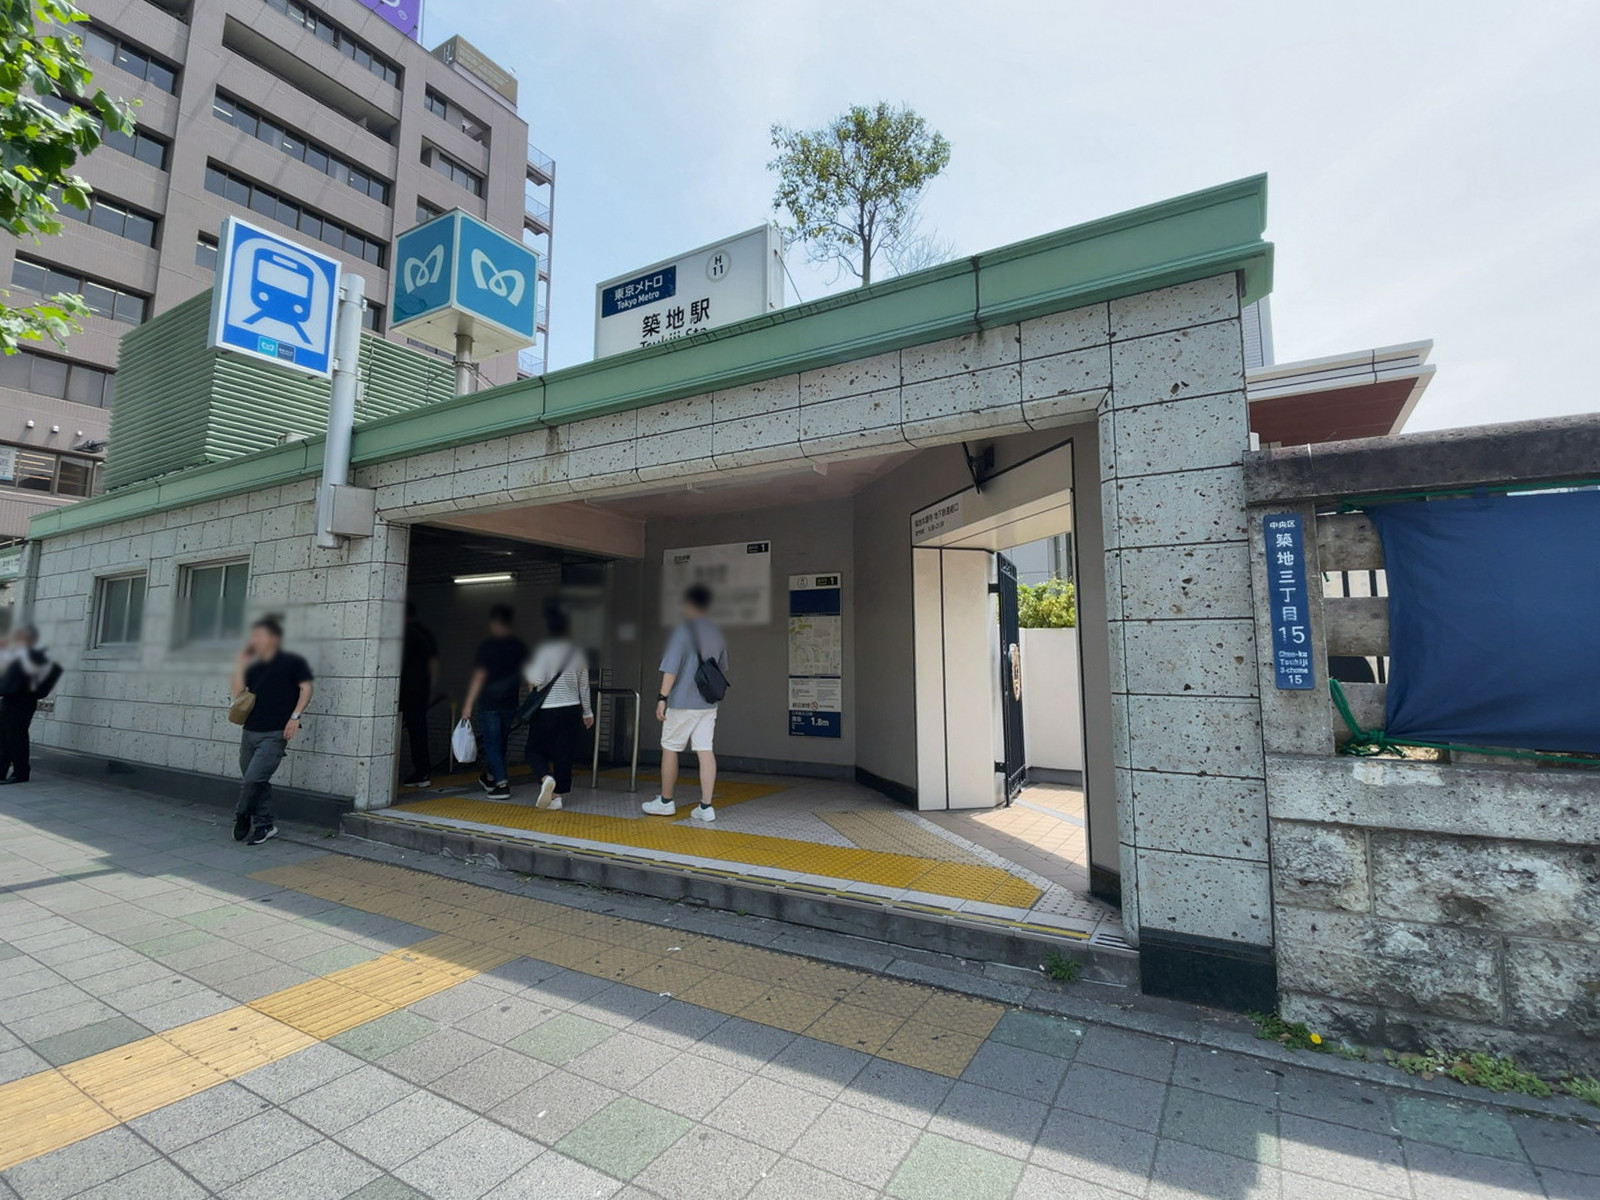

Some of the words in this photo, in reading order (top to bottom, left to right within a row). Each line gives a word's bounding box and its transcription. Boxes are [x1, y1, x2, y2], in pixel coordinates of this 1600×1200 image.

[715, 255, 722, 265] H
[713, 264, 724, 276] 11
[614, 274, 663, 301] 東京メトロ
[617, 298, 637, 310] Tokyo
[637, 290, 660, 303] Metro
[642, 297, 710, 338] 築地駅
[1269, 519, 1296, 529] 中央区
[1275, 533, 1297, 622] 築地三丁目
[1278, 626, 1305, 643] 15
[1288, 675, 1302, 684] 15
[810, 717, 830, 727] 1.8m
